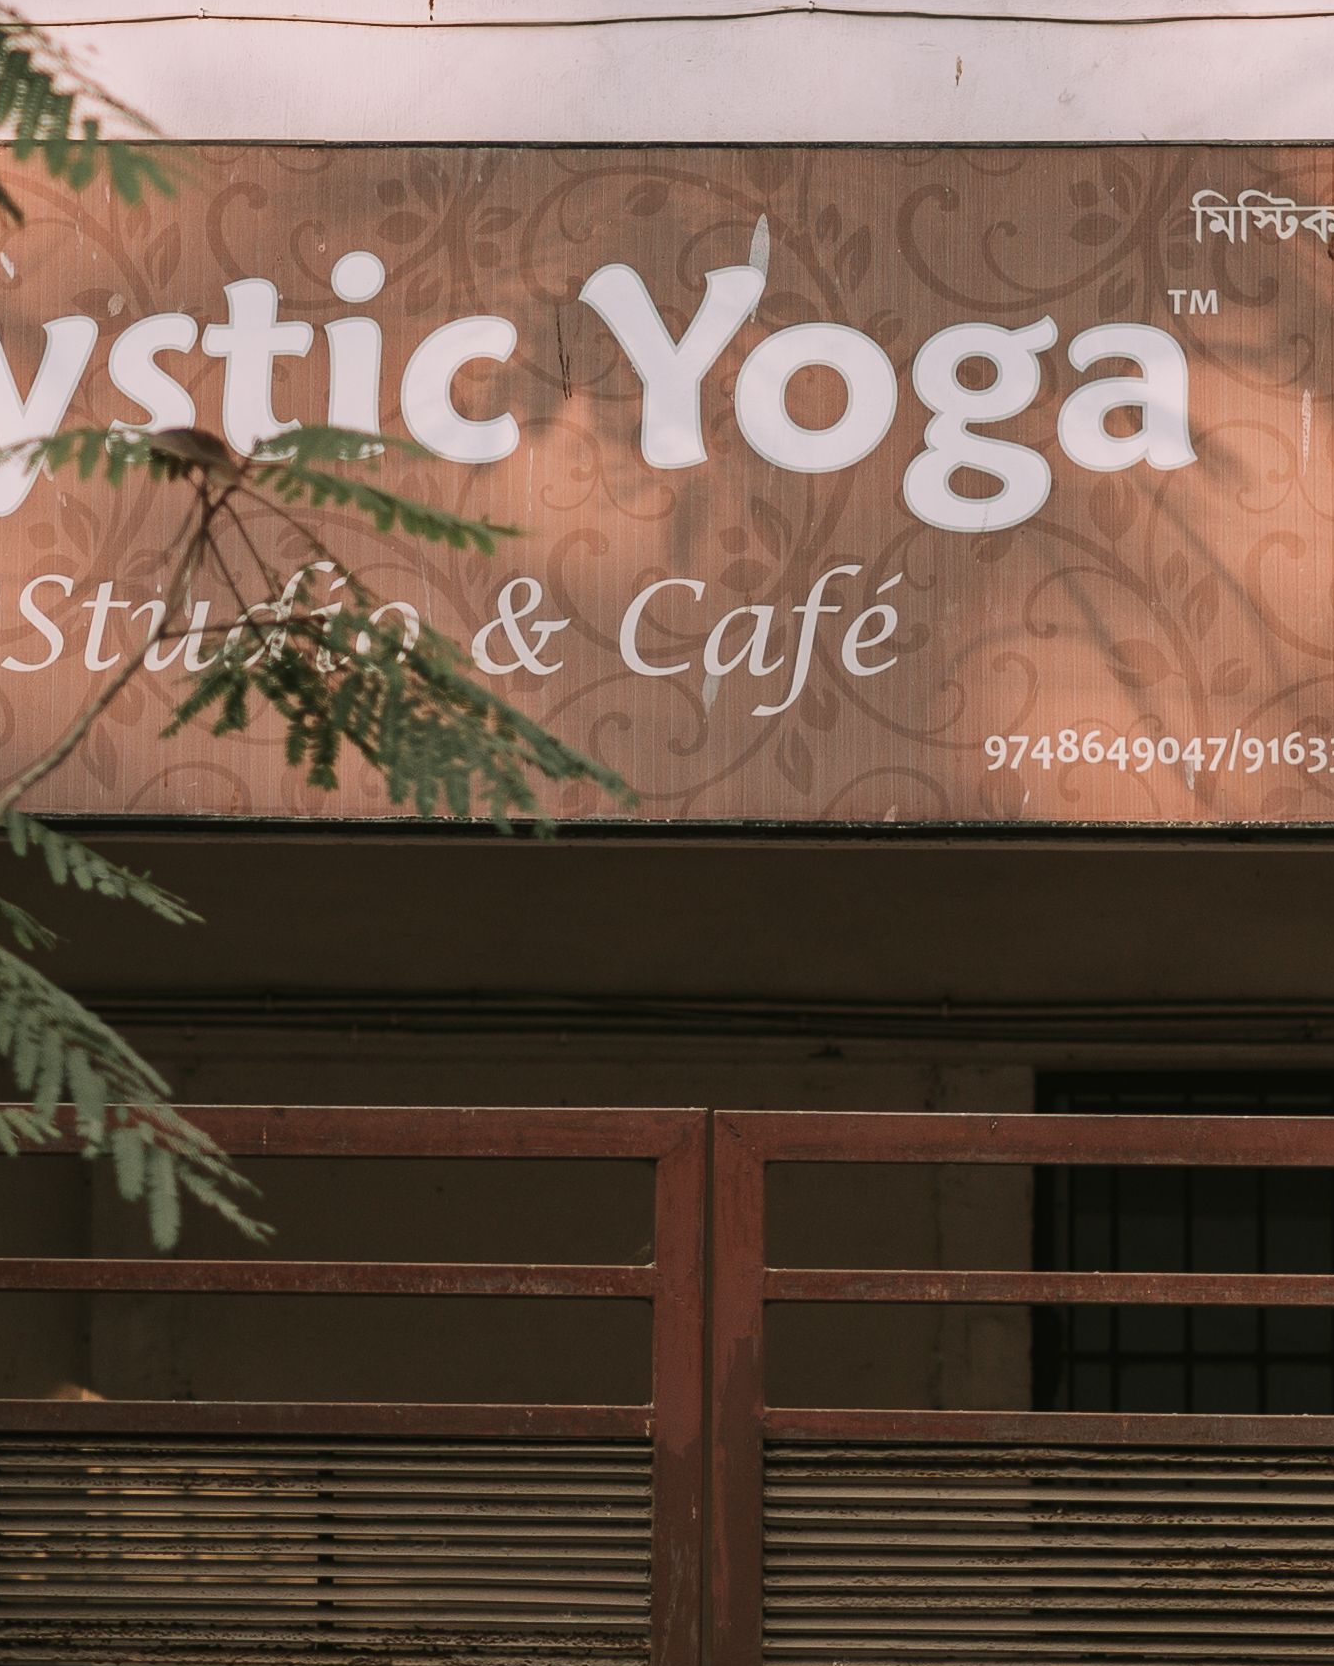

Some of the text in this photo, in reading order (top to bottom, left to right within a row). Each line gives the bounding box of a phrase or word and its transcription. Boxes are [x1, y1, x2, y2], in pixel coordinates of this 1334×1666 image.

[578, 261, 1198, 533] Yoga
[470, 576, 572, 676] &
[618, 563, 904, 716] Café
